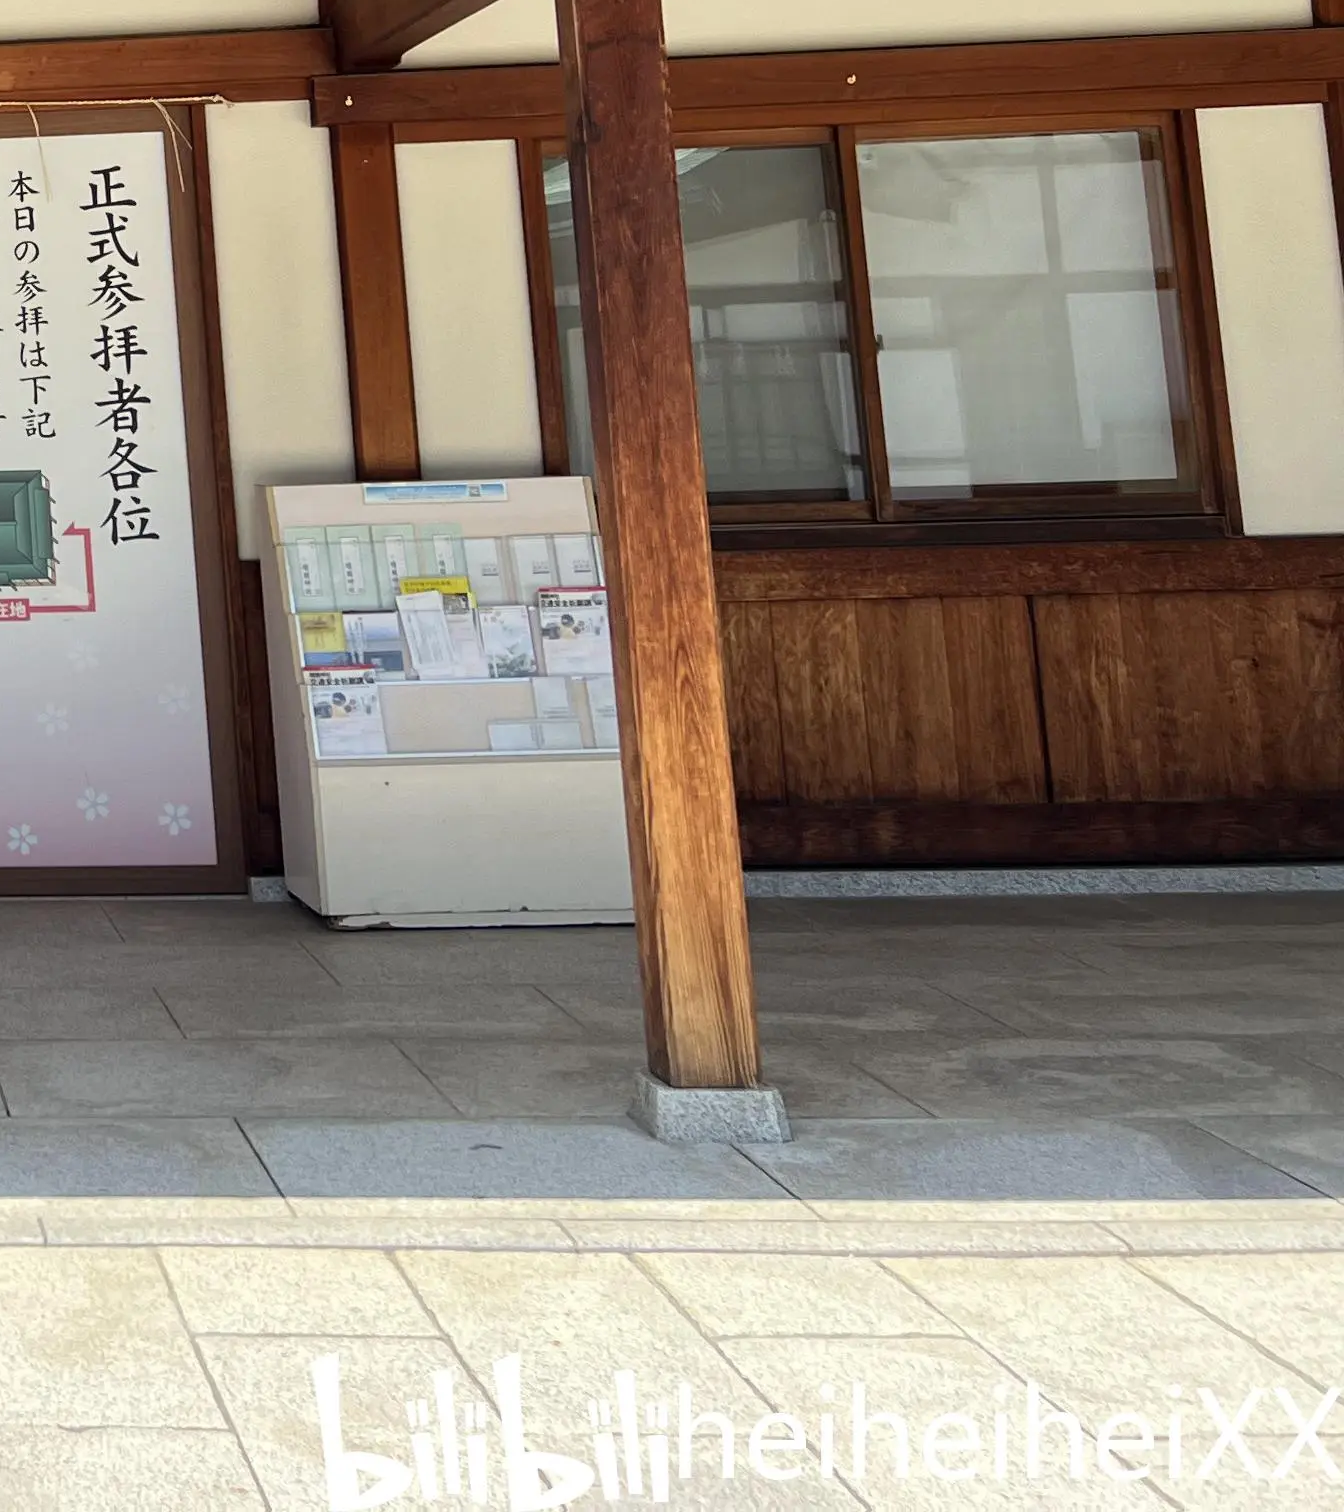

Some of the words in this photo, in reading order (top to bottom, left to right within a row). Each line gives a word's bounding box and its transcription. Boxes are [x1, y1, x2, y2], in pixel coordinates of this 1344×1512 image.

[7, 170, 57, 439] 本日の参拝は下記
[78, 163, 160, 547] 正式参拝者各位
